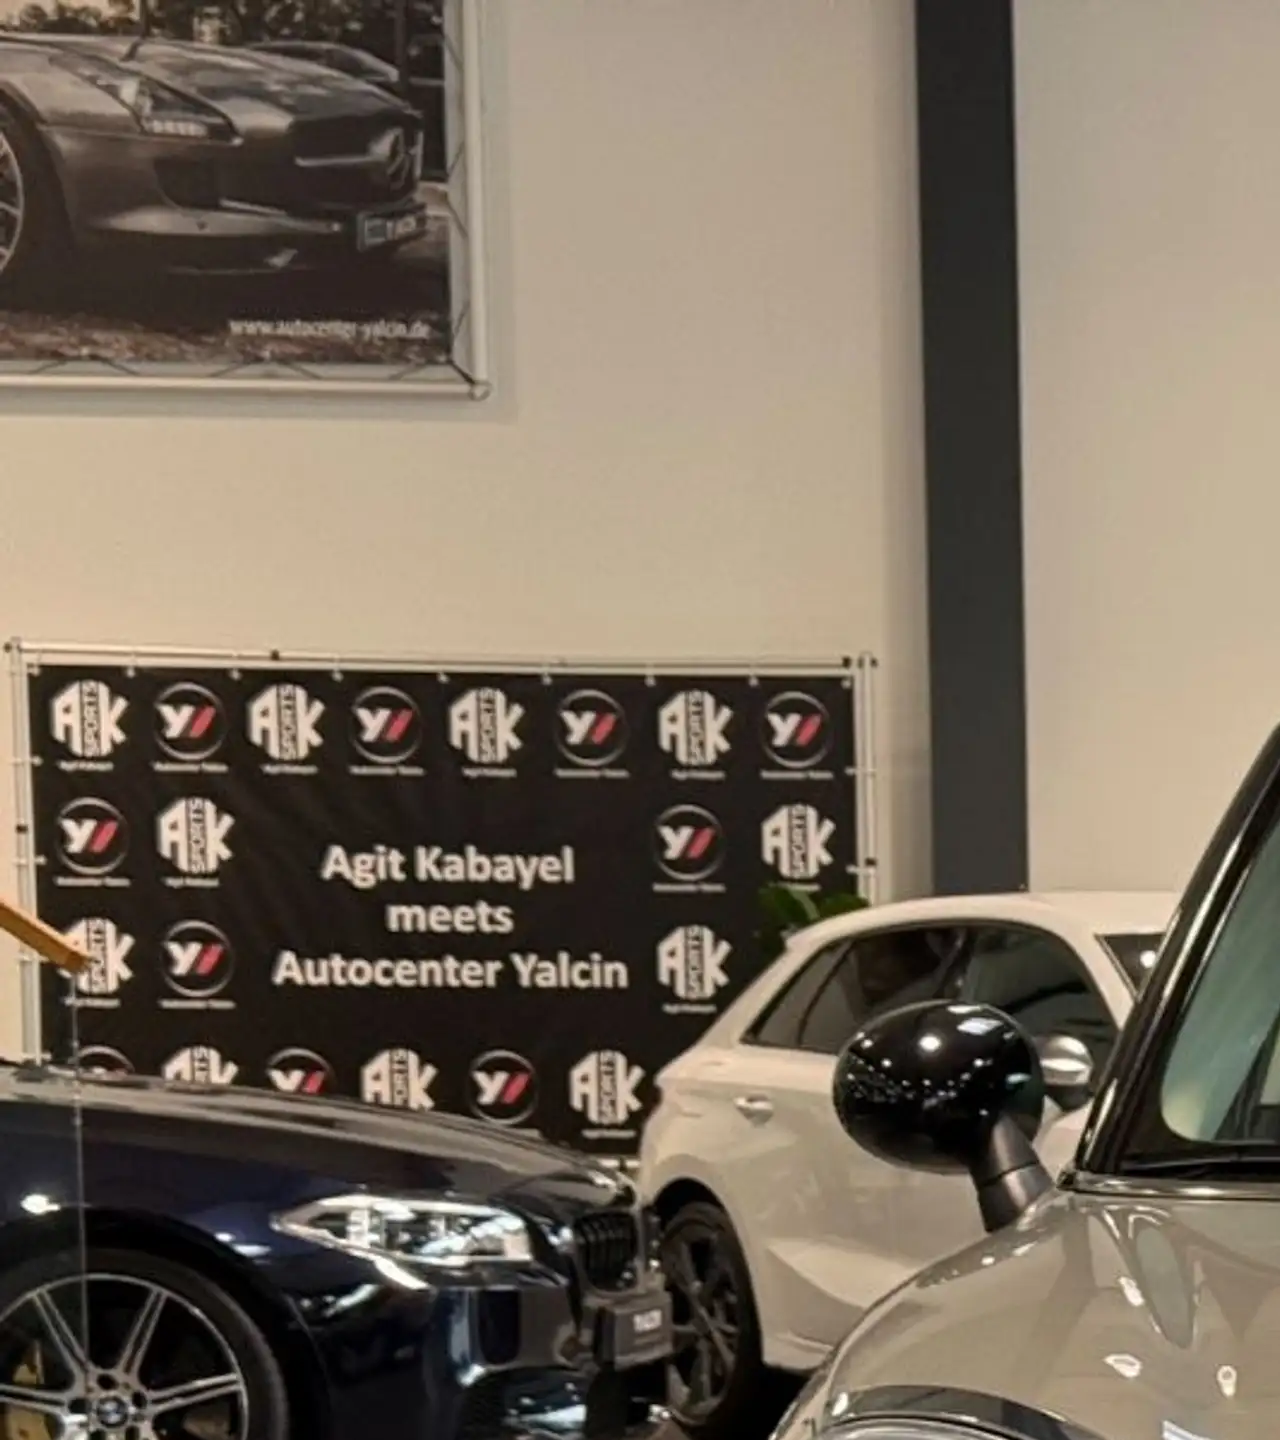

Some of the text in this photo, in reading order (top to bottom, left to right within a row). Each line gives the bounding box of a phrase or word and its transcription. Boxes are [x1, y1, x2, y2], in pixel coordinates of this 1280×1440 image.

[320, 844, 576, 891] Agit Kabayel
[385, 901, 515, 934] meets
[272, 949, 630, 989] Autocenter Yalcin
